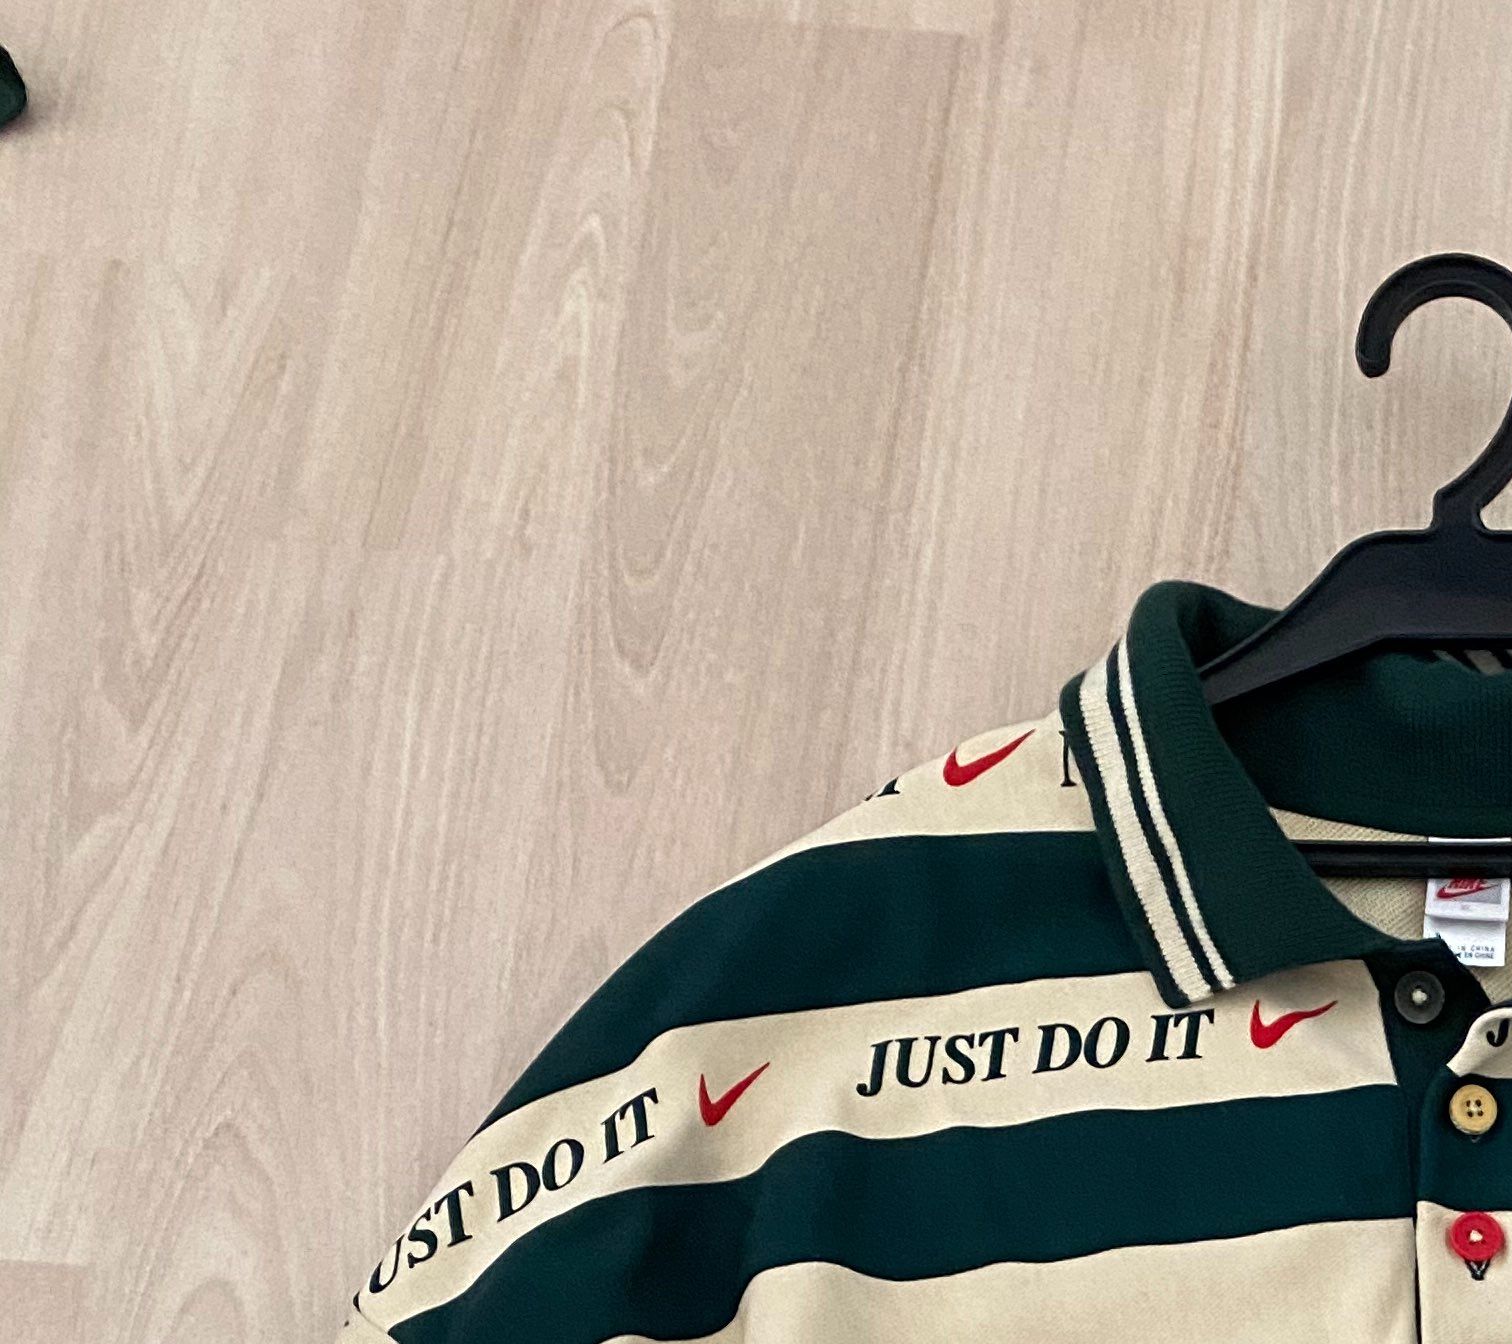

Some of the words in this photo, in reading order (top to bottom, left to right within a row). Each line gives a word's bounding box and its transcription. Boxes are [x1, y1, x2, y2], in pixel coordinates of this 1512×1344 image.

[857, 1026, 1020, 1098] JUST
[1032, 1015, 1131, 1075] DO
[1145, 1008, 1216, 1062] IT
[354, 1181, 475, 1311] UST
[489, 1138, 585, 1224] DO
[600, 1088, 660, 1164] IT
